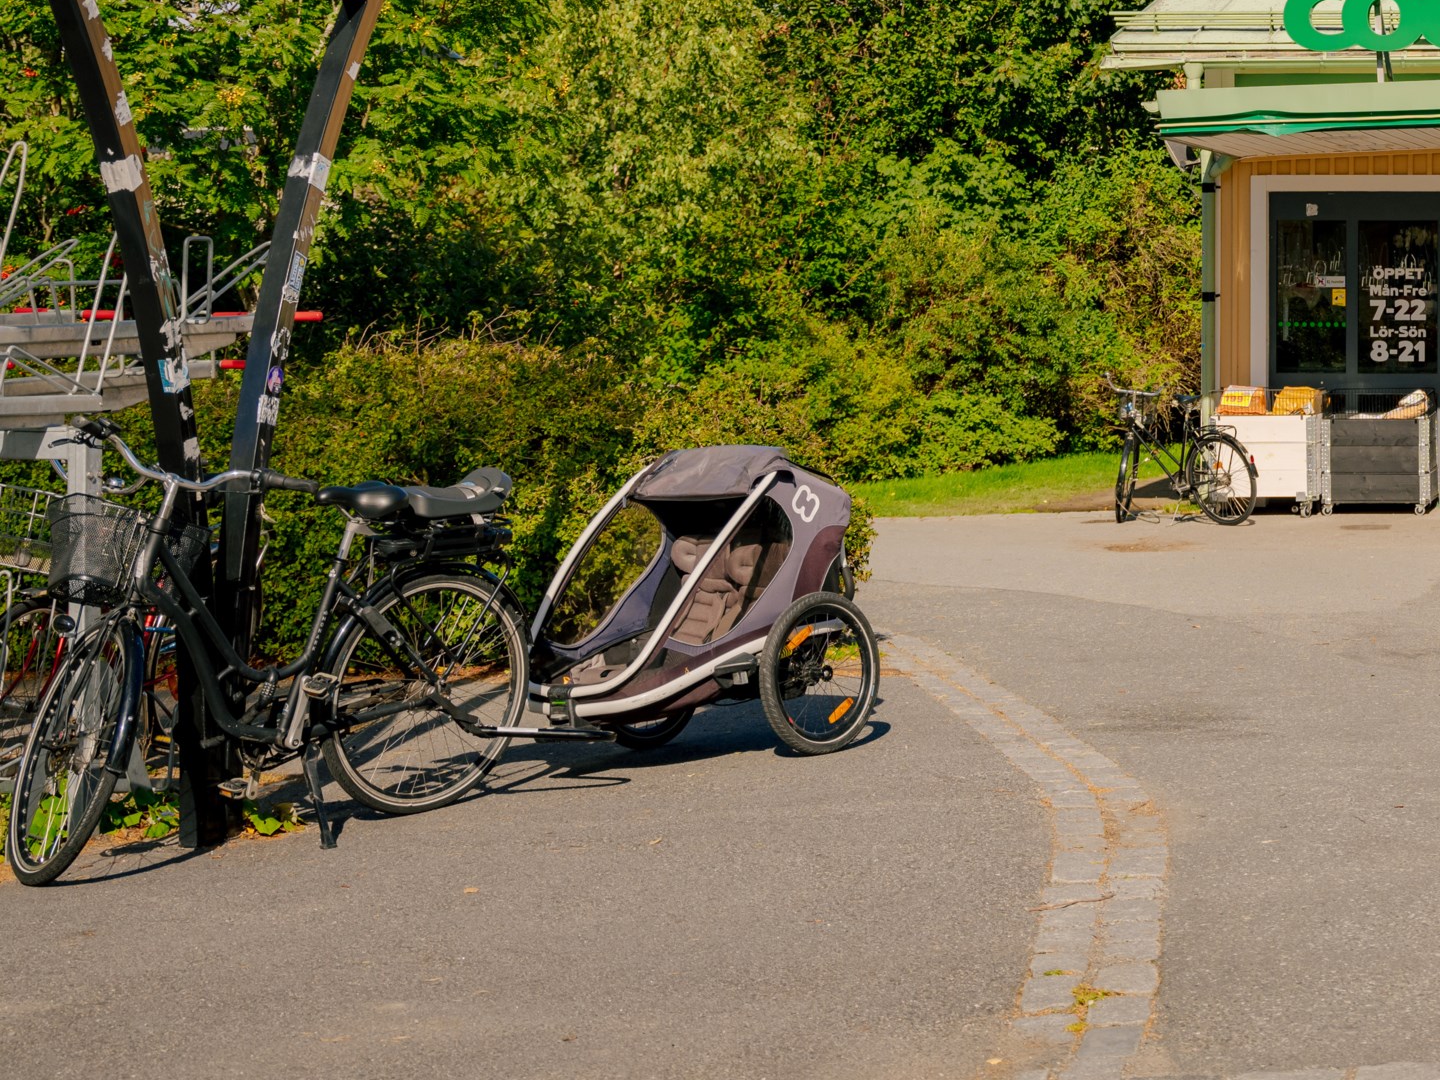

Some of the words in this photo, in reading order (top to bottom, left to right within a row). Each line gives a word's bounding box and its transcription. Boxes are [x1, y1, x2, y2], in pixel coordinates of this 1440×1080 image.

[1373, 265, 1424, 279] ÖPPET
[1370, 284, 1427, 296] Mån-Fre
[1370, 299, 1426, 320] 7-22
[1370, 326, 1427, 337] Lör-Sön
[1370, 341, 1425, 362] 8-21
